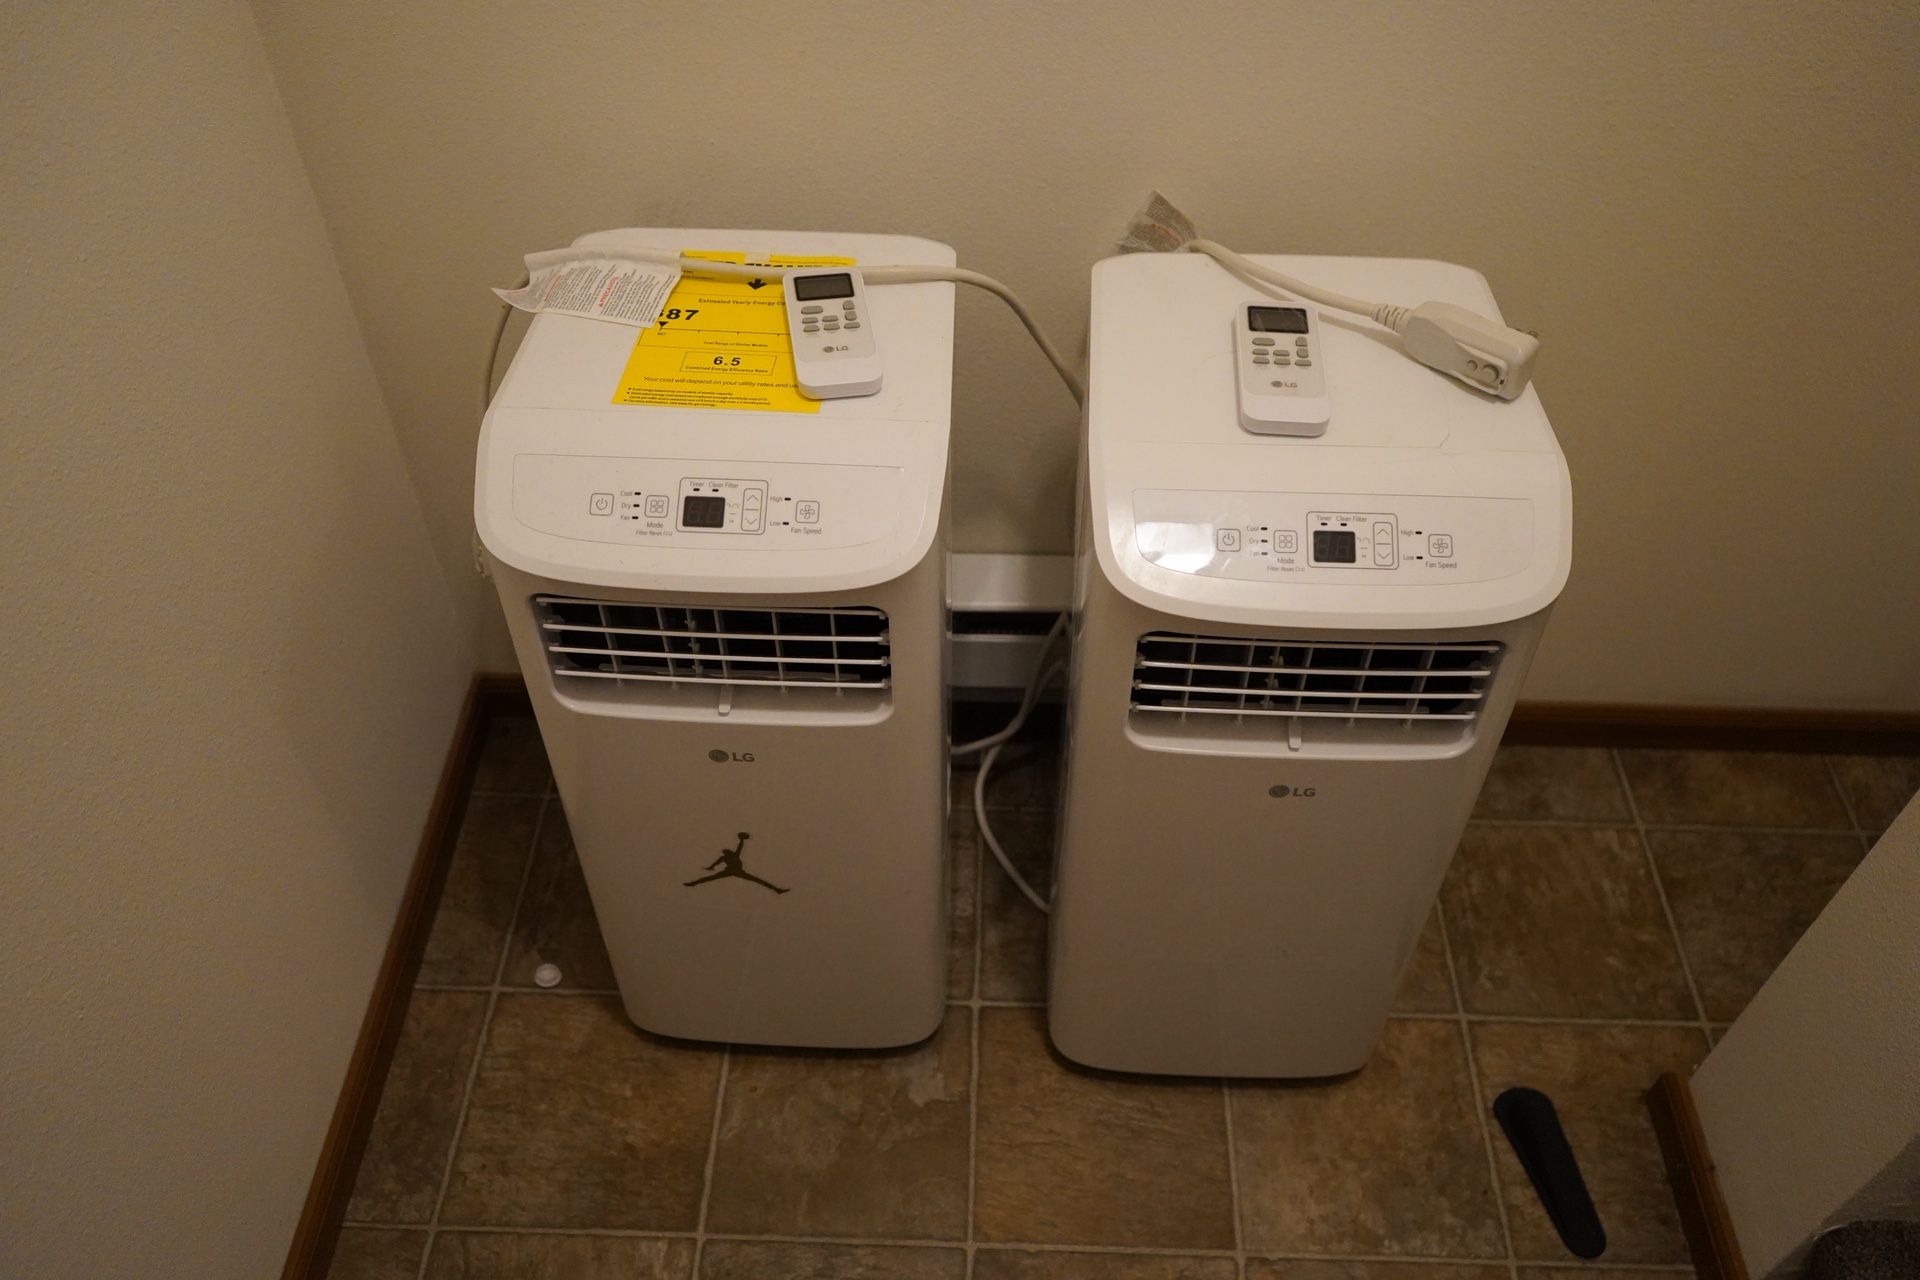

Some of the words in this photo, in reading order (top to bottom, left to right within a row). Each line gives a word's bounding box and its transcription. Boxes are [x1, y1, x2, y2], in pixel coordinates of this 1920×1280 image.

[713, 356, 741, 367] 6.5
[770, 495, 783, 504] High
[621, 502, 631, 510] Dry
[646, 521, 664, 529] Mode
[803, 527, 822, 535] Speed
[1400, 529, 1414, 537] High
[1249, 537, 1259, 545] Dry
[1437, 561, 1458, 569] Speed
